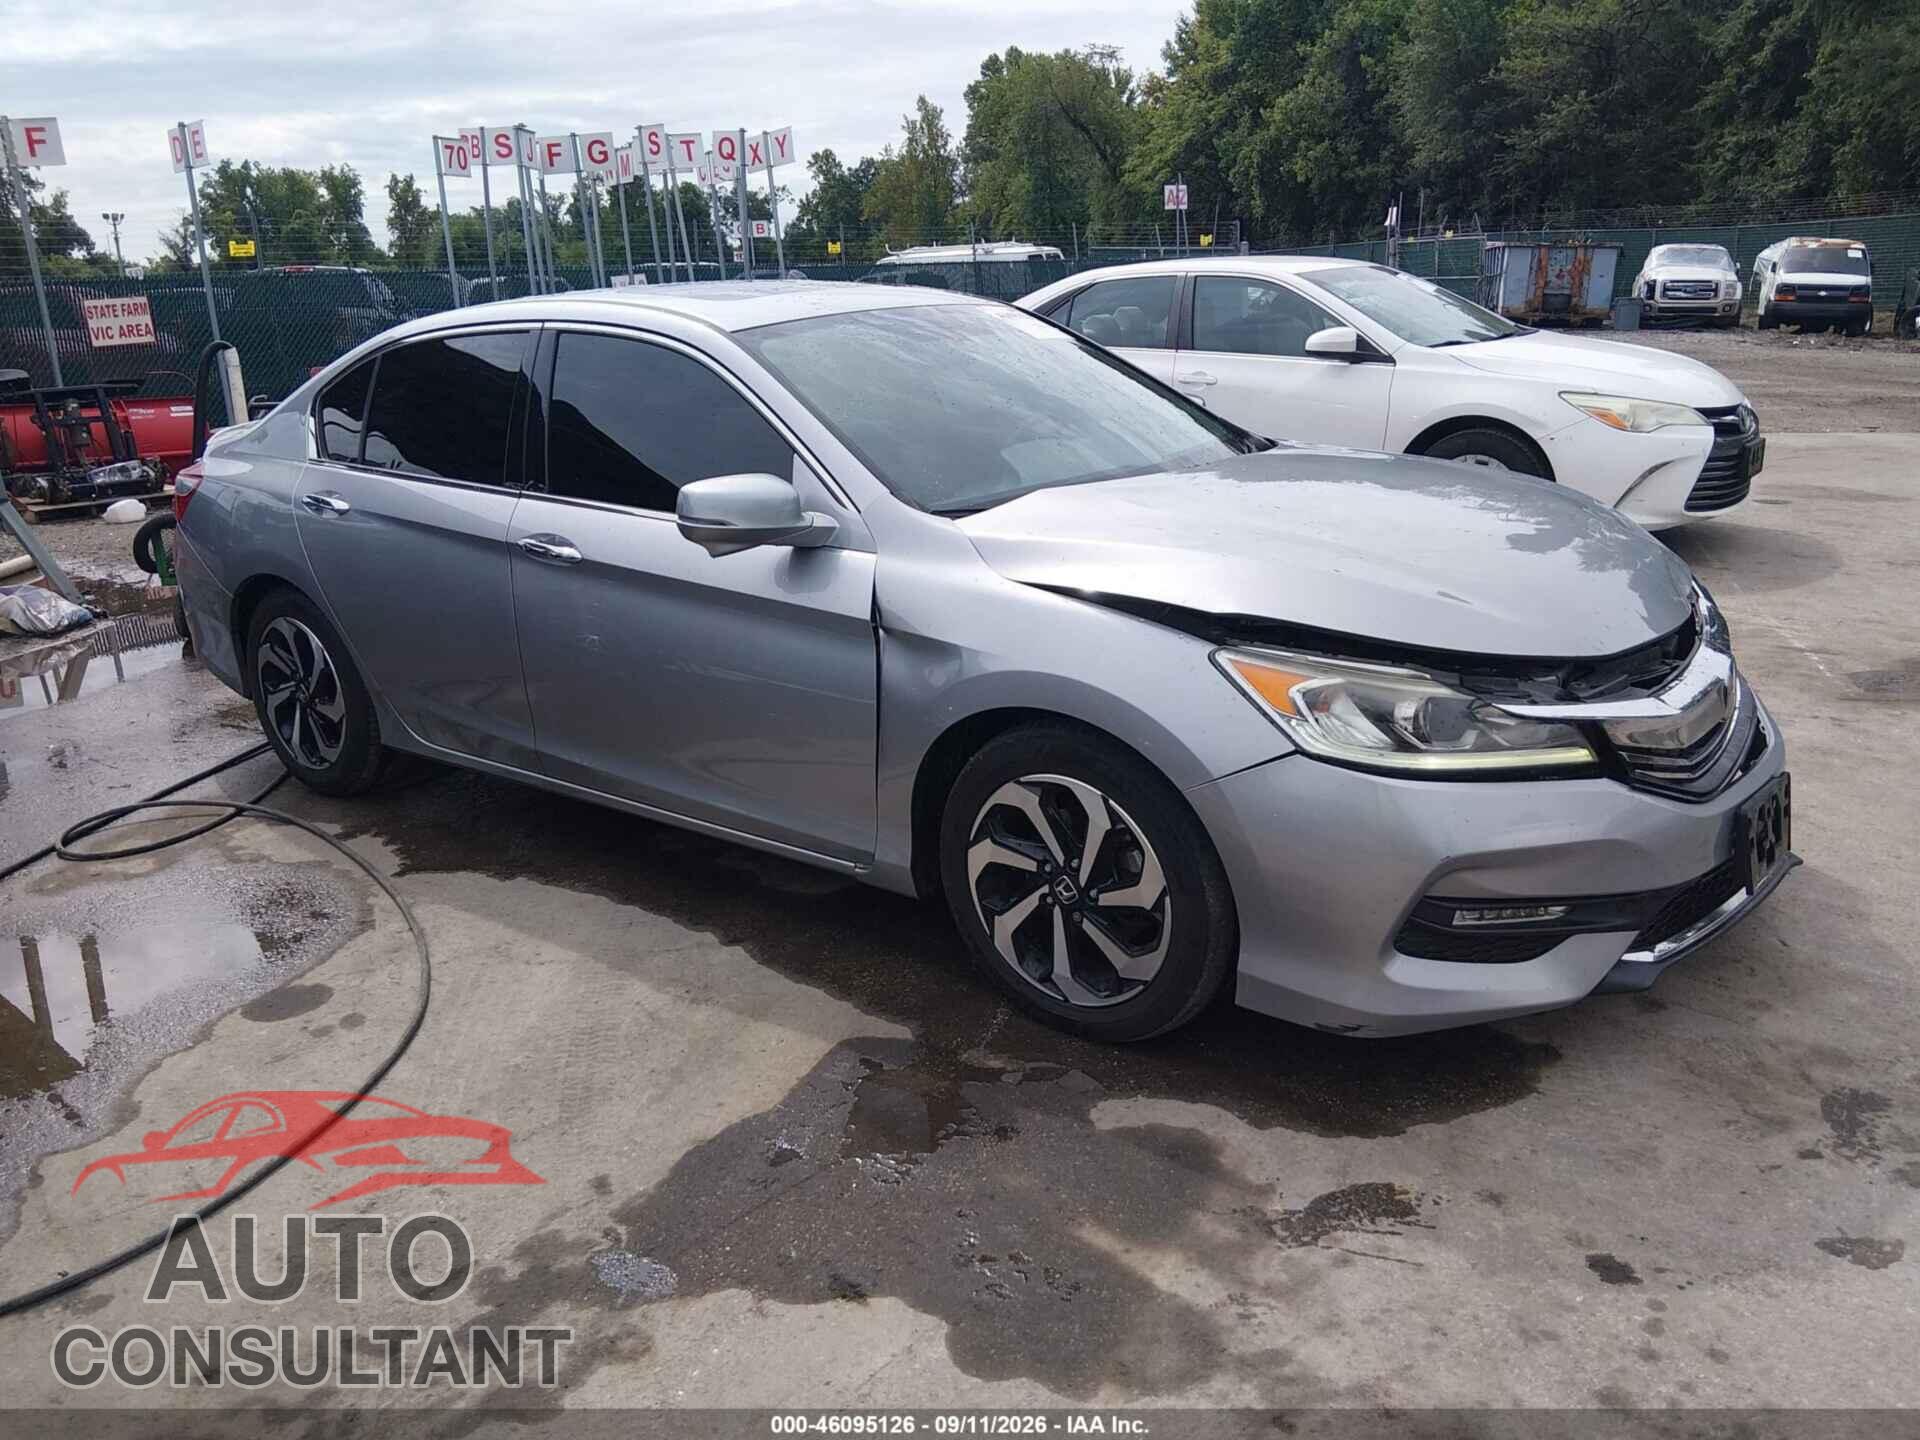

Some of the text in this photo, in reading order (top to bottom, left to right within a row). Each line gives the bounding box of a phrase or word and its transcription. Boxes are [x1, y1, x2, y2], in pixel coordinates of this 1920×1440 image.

[24, 126, 47, 158] F
[172, 135, 183, 164] D
[191, 129, 204, 159] E
[494, 133, 513, 159] S
[546, 142, 562, 168] F
[587, 139, 609, 165] G
[648, 131, 661, 156] S
[680, 139, 696, 162] T
[718, 136, 736, 161] Q
[749, 141, 763, 167] X
[774, 133, 787, 159] Y
[444, 144, 468, 170] 70
[756, 223, 766, 235] B
[86, 301, 149, 320] STATE FARM
[91, 322, 154, 341] VIC AREA
